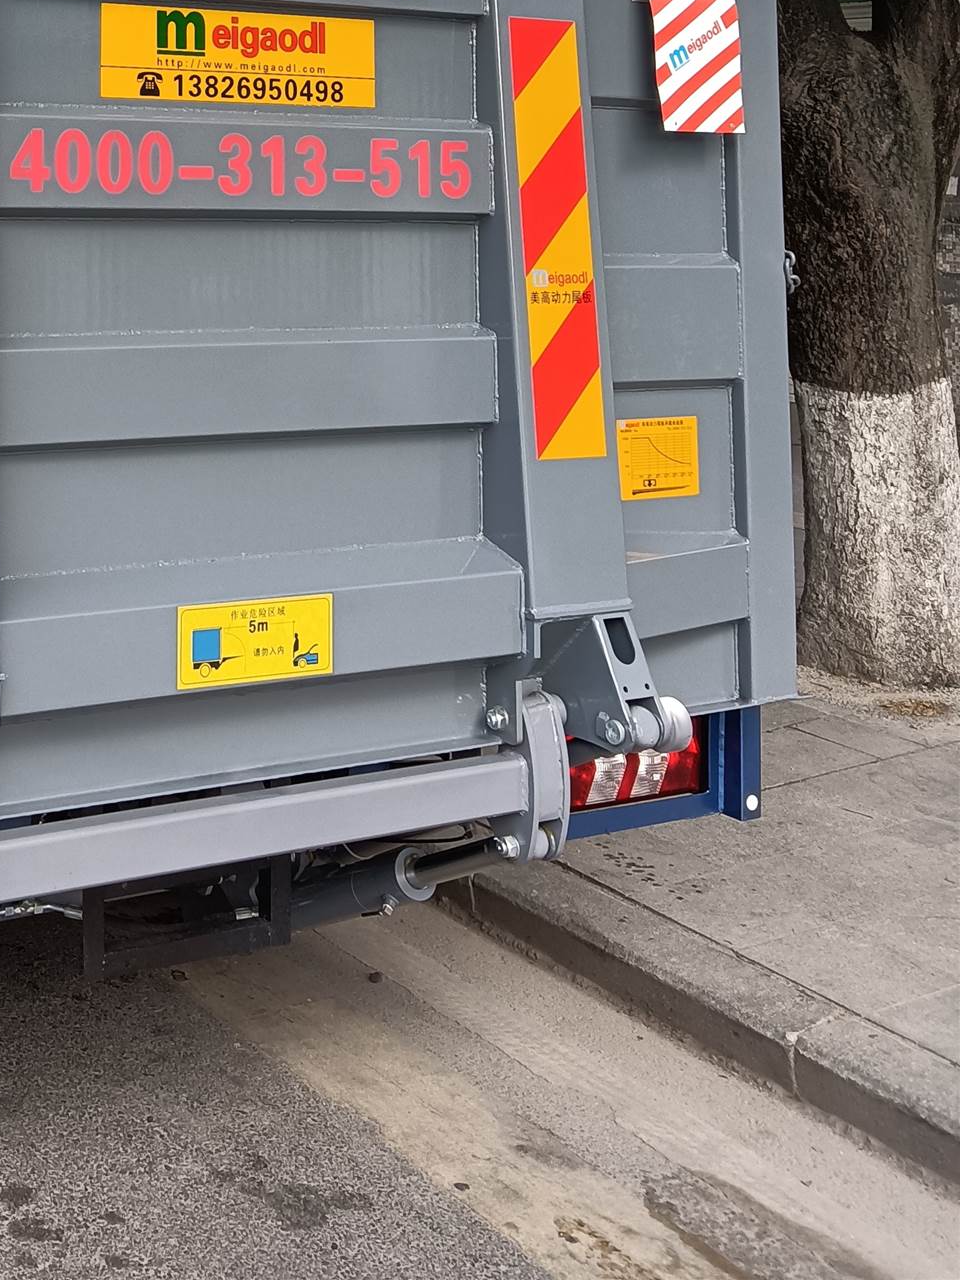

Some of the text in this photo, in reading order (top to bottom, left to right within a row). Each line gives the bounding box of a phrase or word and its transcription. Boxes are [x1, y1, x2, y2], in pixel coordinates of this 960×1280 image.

[157, 57, 326, 74] http://www.meigaodl.com
[173, 74, 344, 103] 13826950498
[10, 128, 473, 200] 4000-313-515
[530, 291, 592, 304] 美高动力尾板
[230, 606, 286, 621] 作业危险区域
[249, 620, 268, 633] 5m
